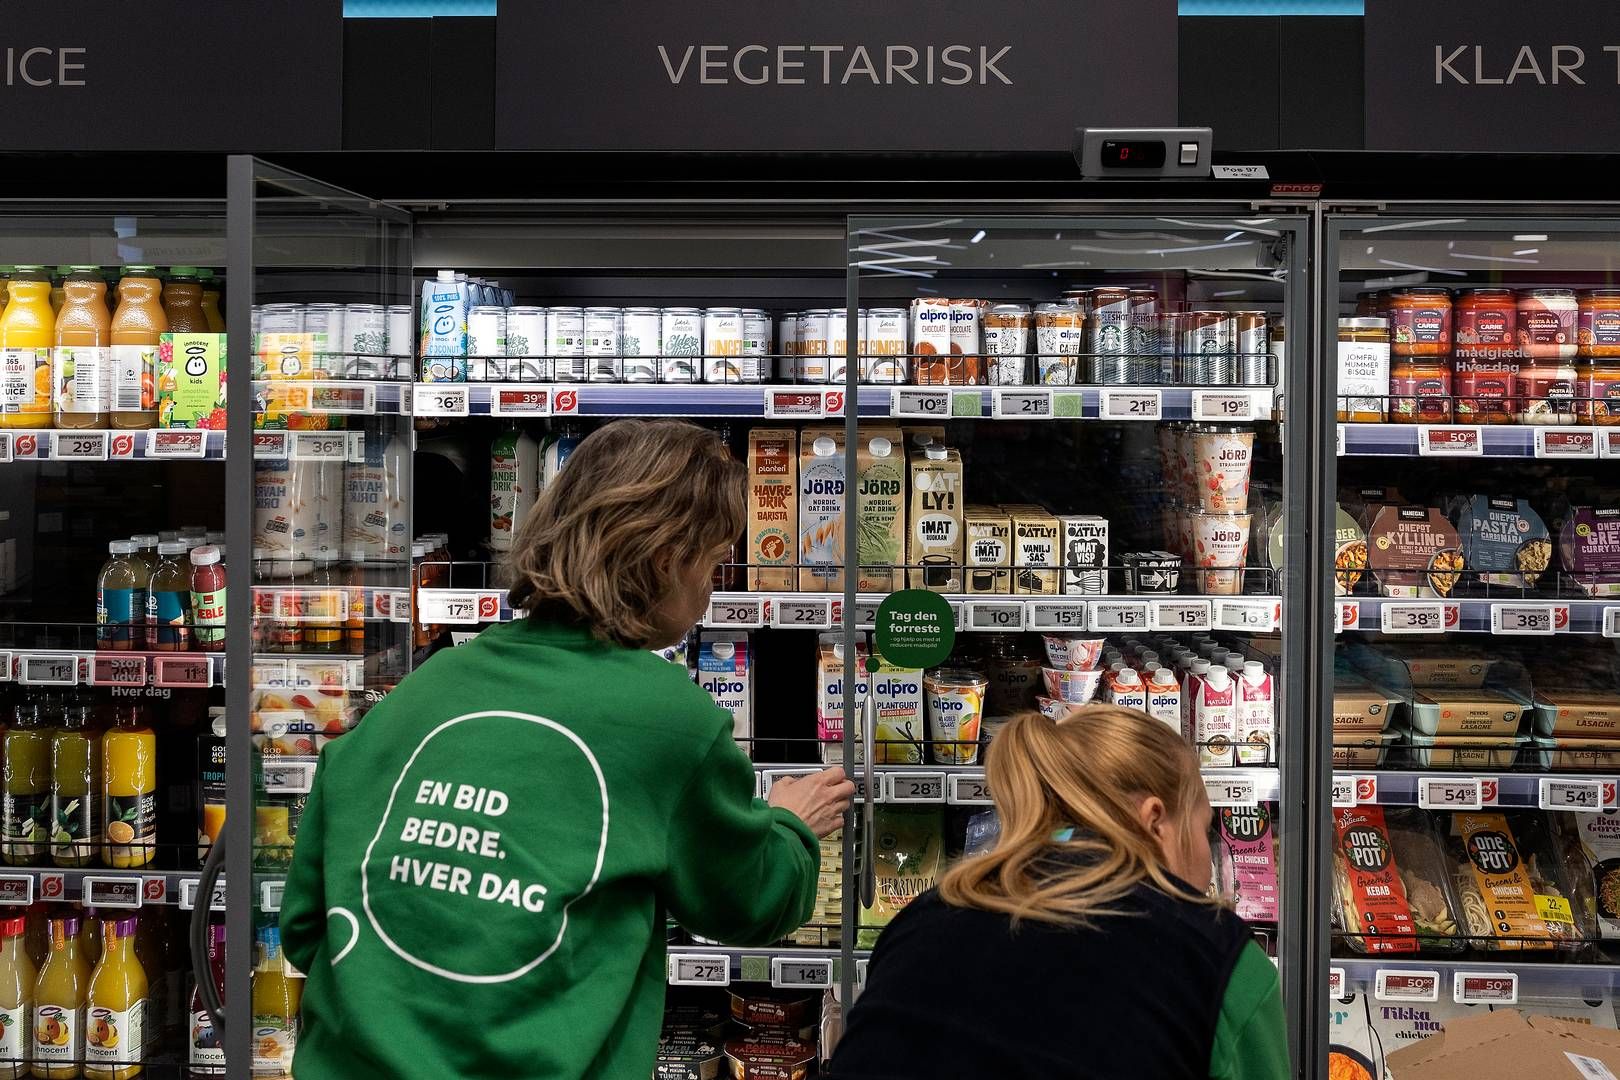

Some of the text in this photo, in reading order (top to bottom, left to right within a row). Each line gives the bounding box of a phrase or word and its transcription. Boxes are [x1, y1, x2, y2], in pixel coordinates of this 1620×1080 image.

[658, 44, 1014, 86] VEGETARISK
[1434, 45, 1586, 86] KLAR
[1223, 166, 1244, 174] Pos
[920, 309, 948, 323] alpro
[921, 324, 946, 333] CHOCOLATE
[1346, 354, 1378, 362] JOMFRU
[1344, 361, 1379, 369] HUMMER
[1456, 362, 1520, 375] Hver dag
[1347, 368, 1376, 376] BISQUE
[493, 481, 512, 492] DRIK
[753, 485, 792, 497] HAVRE
[758, 496, 788, 509] DRIK
[922, 491, 955, 510] LY!
[757, 511, 788, 521] BARISTA
[1489, 512, 1521, 521] ONEPOT
[969, 526, 1009, 537] OATLY!
[1017, 527, 1057, 538] OATLY!
[1067, 526, 1106, 538] OATLY!
[1398, 523, 1432, 533] ONEPOT
[1472, 518, 1519, 536] PASTA
[1386, 531, 1446, 547] KYLLING
[1480, 531, 1523, 544] CARBONARA
[1023, 544, 1051, 553] VANILJ
[1581, 545, 1610, 553] CURRY
[1076, 552, 1095, 563] VISP
[197, 606, 224, 619] ÆBLE
[889, 611, 937, 622] Tag den
[889, 623, 941, 633] forreste
[111, 687, 171, 699] Hver dag
[702, 677, 744, 697] alpro
[876, 678, 919, 698] alpro
[877, 701, 919, 710] PLANTGURT
[932, 699, 963, 715] alpro
[1117, 696, 1143, 708] alpro
[1152, 696, 1178, 708] alpro
[1213, 715, 1225, 723] OAT
[1575, 720, 1616, 728] LASAGNE
[1207, 722, 1231, 730] CUISINE
[414, 780, 509, 817] EN BID
[1232, 816, 1260, 836] POT
[400, 817, 506, 859] BEDRE.
[1350, 831, 1379, 846] one
[1474, 836, 1504, 850] one
[1245, 855, 1269, 865] CHICKEN
[1353, 847, 1382, 867] POT
[1480, 851, 1510, 869] POT
[389, 855, 548, 913] HVER DAG
[1365, 885, 1391, 896] KEBAB
[1492, 886, 1524, 895] CHICKEN
[1380, 1006, 1430, 1021] Tikka
